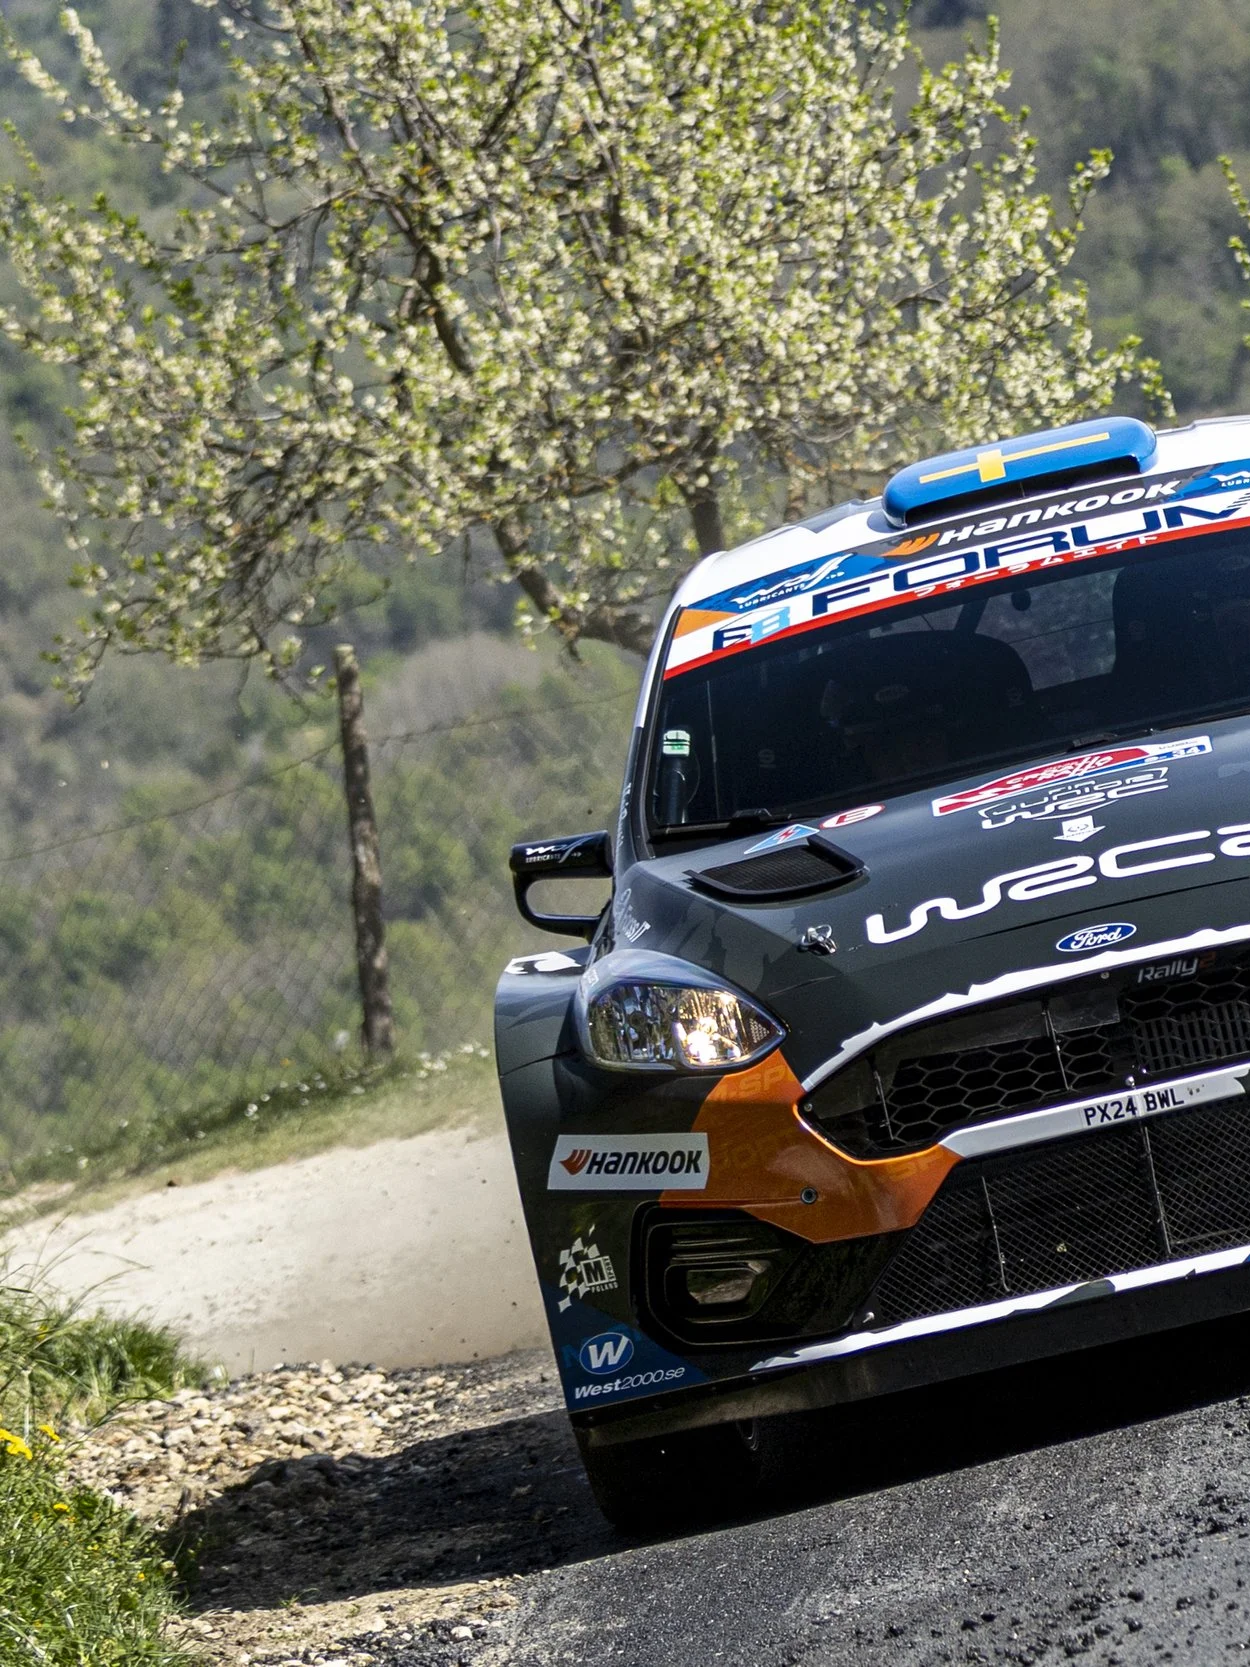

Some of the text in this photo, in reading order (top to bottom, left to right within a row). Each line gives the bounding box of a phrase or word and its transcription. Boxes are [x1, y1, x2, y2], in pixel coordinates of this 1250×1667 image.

[914, 533, 1159, 598] フォーラムエイト
[738, 582, 806, 610] LUBRICANTS
[981, 778, 1170, 830] WRC
[991, 772, 1155, 817] JUNIOR
[1070, 926, 1122, 949] Ford
[1083, 1087, 1185, 1127] PX24 BWL
[590, 1281, 619, 1294] POLAND
[586, 1333, 631, 1370] W
[574, 1365, 686, 1400] West2000.se
